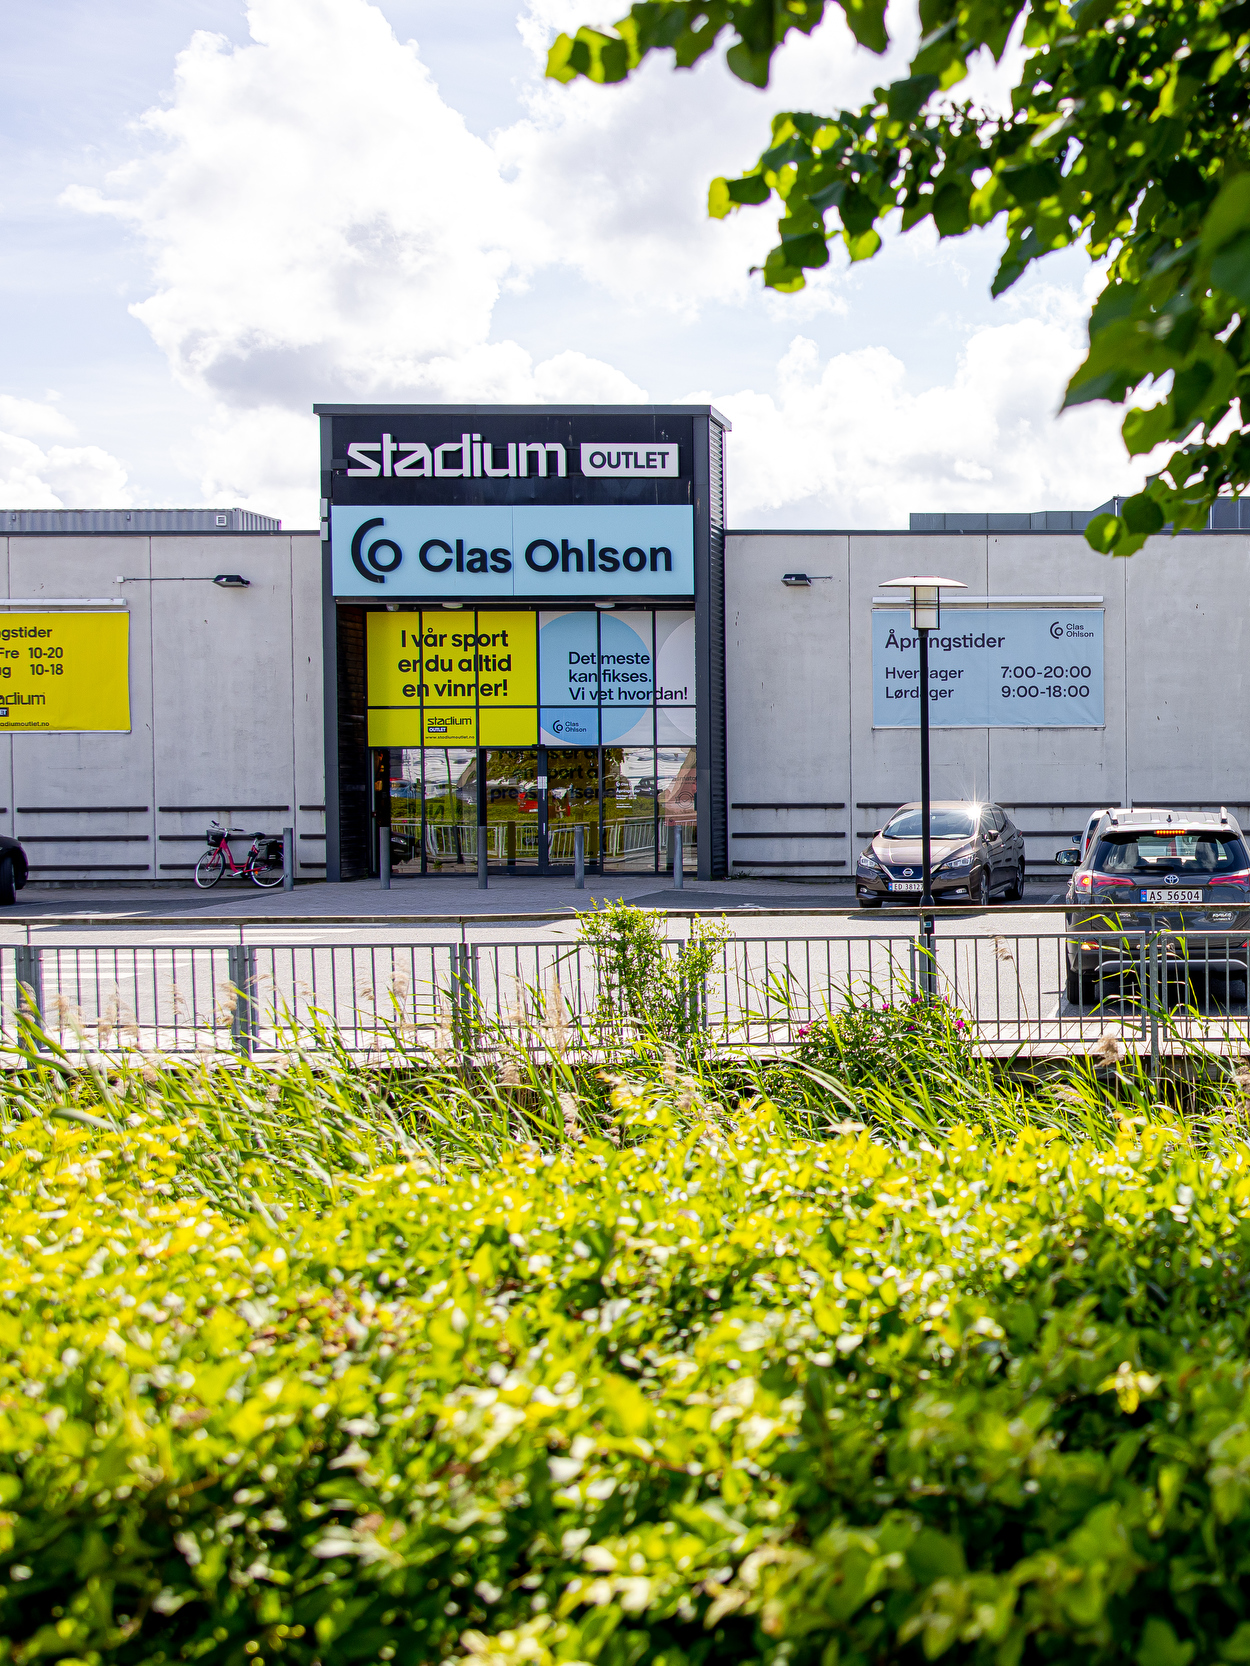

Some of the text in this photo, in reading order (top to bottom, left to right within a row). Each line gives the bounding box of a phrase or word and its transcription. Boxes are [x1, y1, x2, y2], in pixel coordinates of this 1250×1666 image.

[347, 433, 670, 477] stadium OUTLET
[418, 538, 673, 574] Clas Ohlson
[0, 627, 53, 641] gstider
[1066, 623, 1084, 631] Clas
[1066, 630, 1094, 638] Ohlson
[401, 627, 509, 652] I vår sport
[28, 647, 64, 659] 10-20
[568, 651, 650, 665] Det meste
[30, 664, 64, 676] 10-18
[398, 654, 512, 673] er du alltid
[569, 669, 652, 683] kan fikses.
[885, 666, 1092, 682] Hverager 7:00-20:00
[402, 679, 508, 698] en vinner!
[569, 686, 688, 700] Vi vet hvordan!
[885, 685, 1090, 700] Lørdger 9:00-18:00
[427, 716, 472, 726] stadium
[1149, 890, 1200, 901] AS 56504
